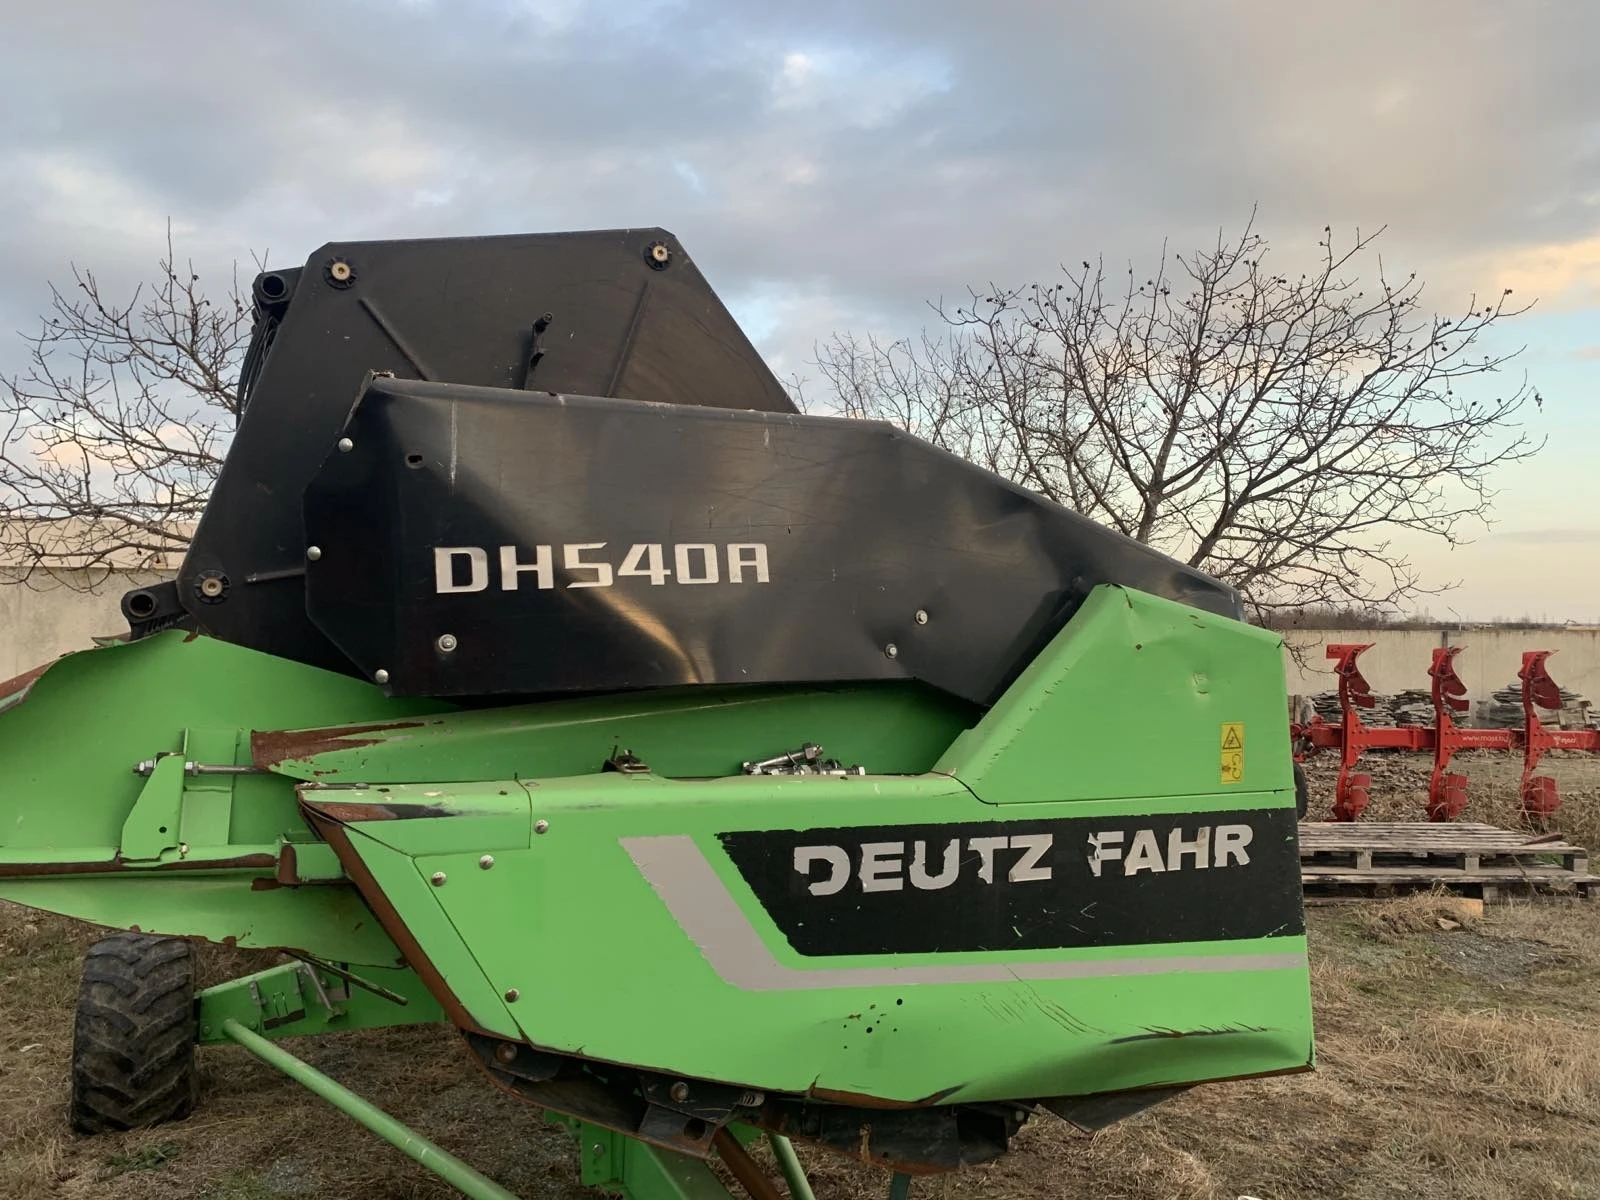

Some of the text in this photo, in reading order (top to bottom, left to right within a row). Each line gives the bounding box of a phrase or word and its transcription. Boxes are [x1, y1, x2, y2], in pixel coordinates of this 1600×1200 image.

[434, 542, 770, 594] DH540A
[793, 824, 1254, 896] DEUTZ FAHR
